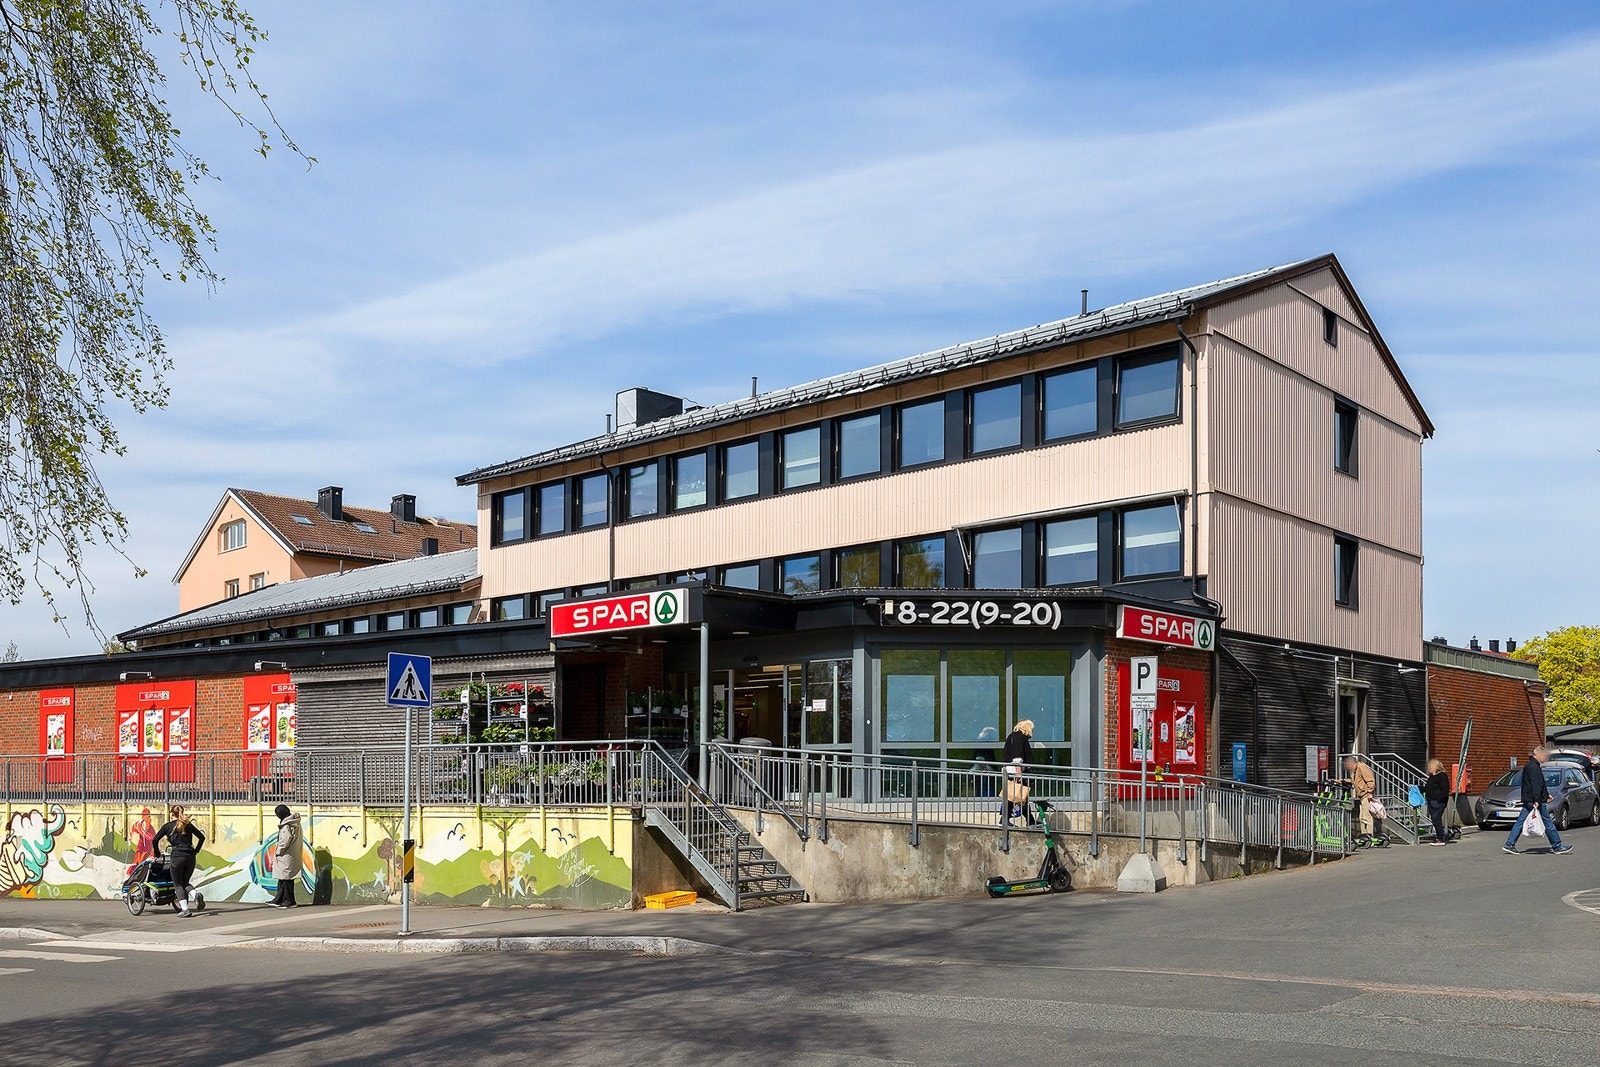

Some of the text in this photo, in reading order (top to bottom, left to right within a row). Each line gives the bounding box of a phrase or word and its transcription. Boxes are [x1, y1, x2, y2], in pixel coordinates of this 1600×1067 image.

[573, 600, 648, 628] SPAR
[898, 601, 1062, 630] 8-22(9-20)
[1141, 614, 1194, 641] SPAR
[1137, 662, 1151, 690] P
[144, 692, 162, 700] SPAR
